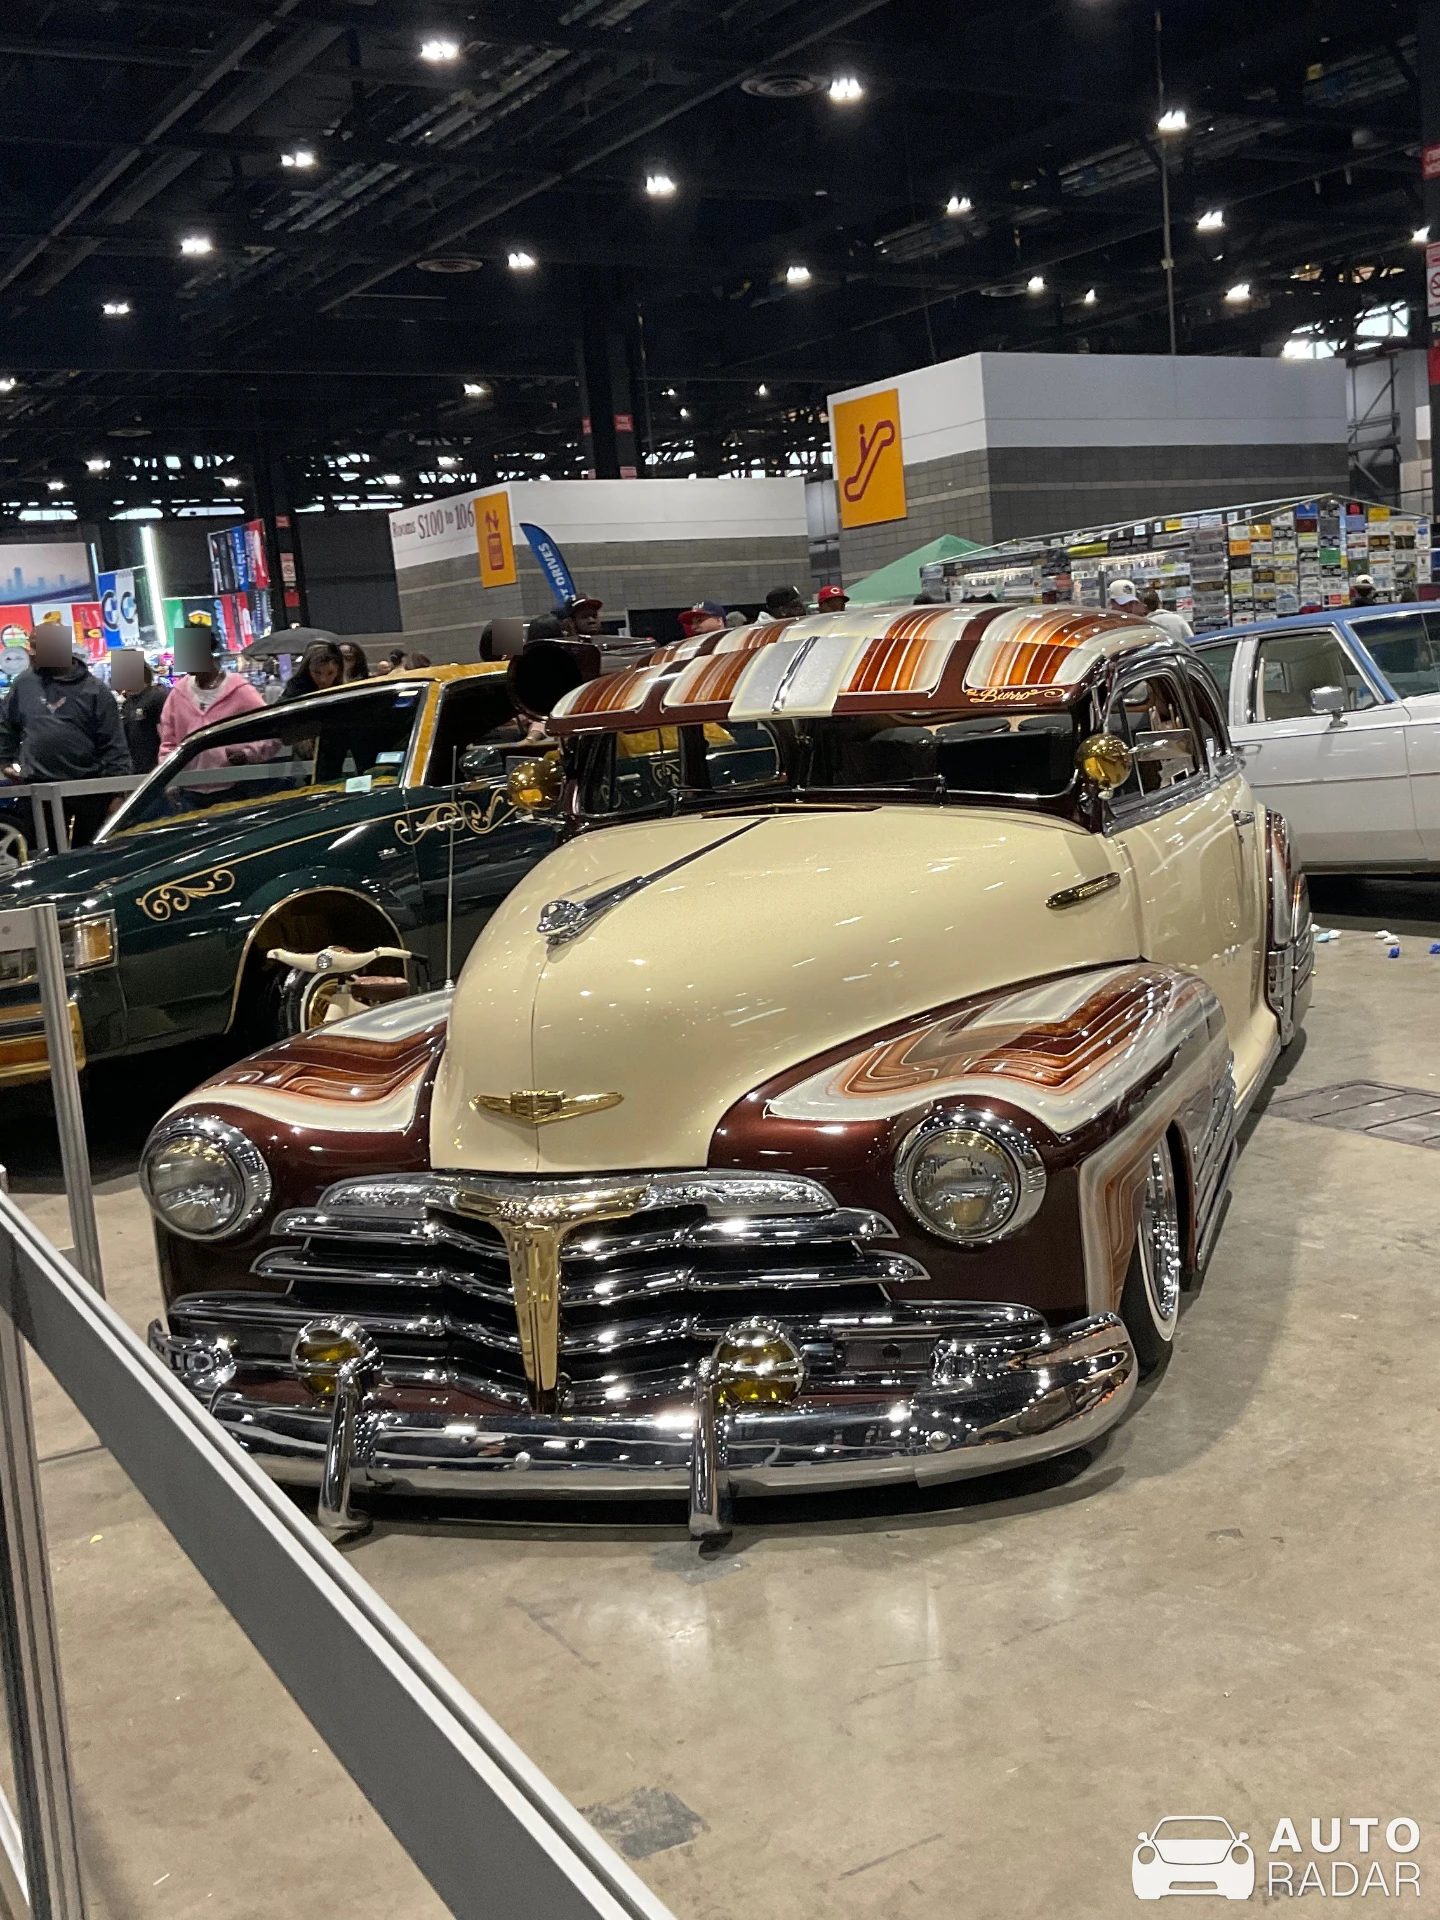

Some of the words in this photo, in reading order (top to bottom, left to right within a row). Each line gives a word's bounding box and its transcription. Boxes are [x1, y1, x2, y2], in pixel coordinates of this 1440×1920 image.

[392, 521, 416, 538] Rooms
[417, 509, 444, 539] S100
[445, 509, 454, 524] to
[455, 502, 475, 530] 106
[538, 542, 566, 586] DRIVES
